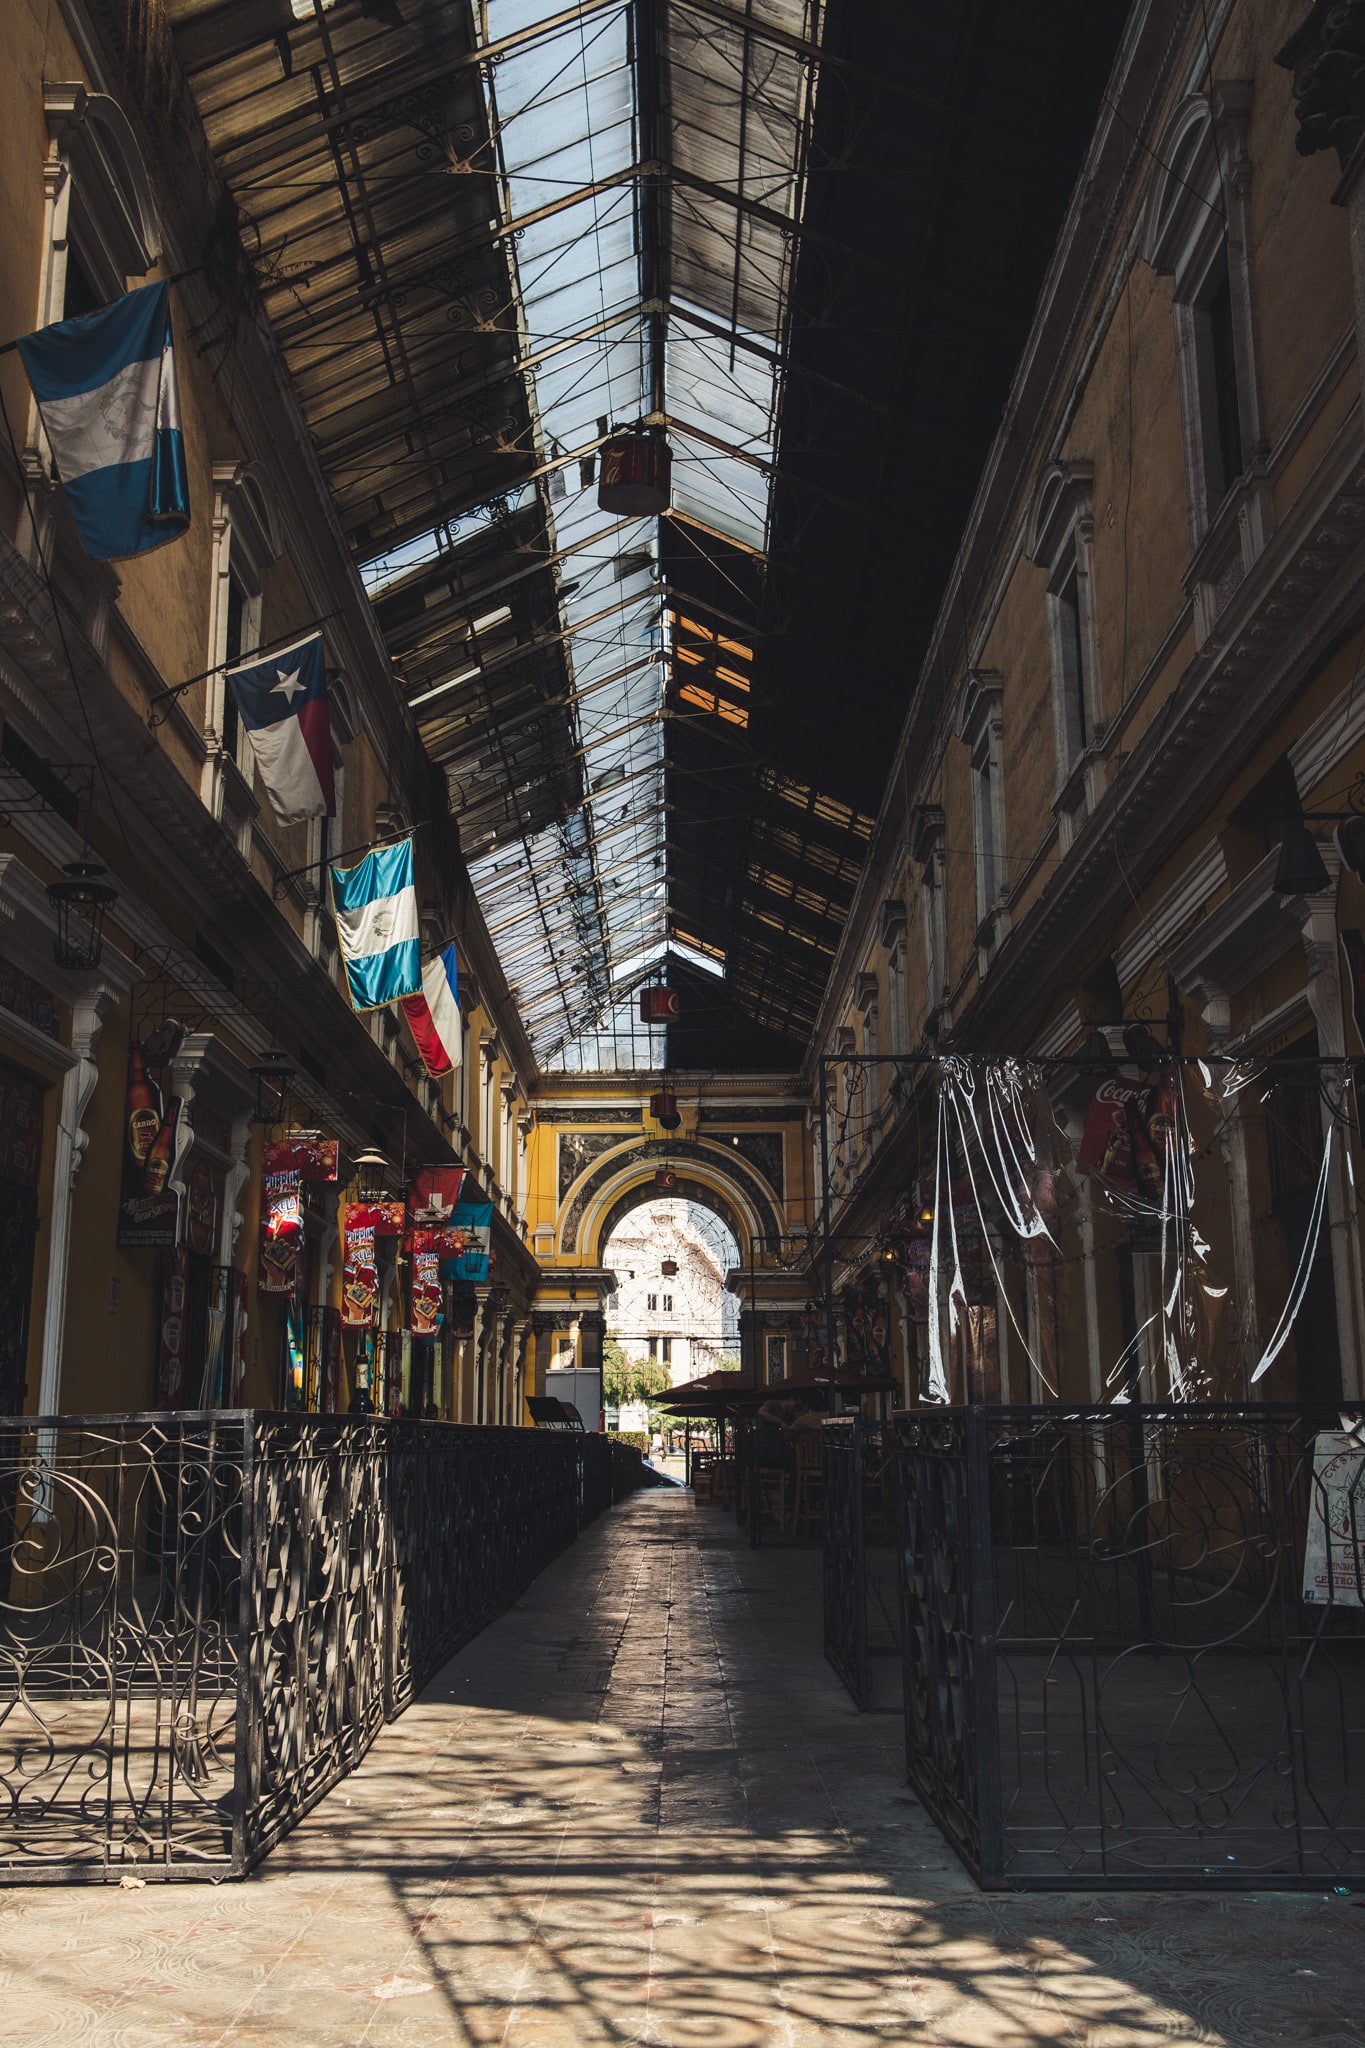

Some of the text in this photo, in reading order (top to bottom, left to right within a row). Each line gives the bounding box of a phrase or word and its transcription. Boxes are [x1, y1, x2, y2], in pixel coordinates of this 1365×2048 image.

[132, 1119, 156, 1129] CABRO
[1323, 1451, 1358, 1479] CASA
[1314, 1575, 1354, 1586] CETRO
